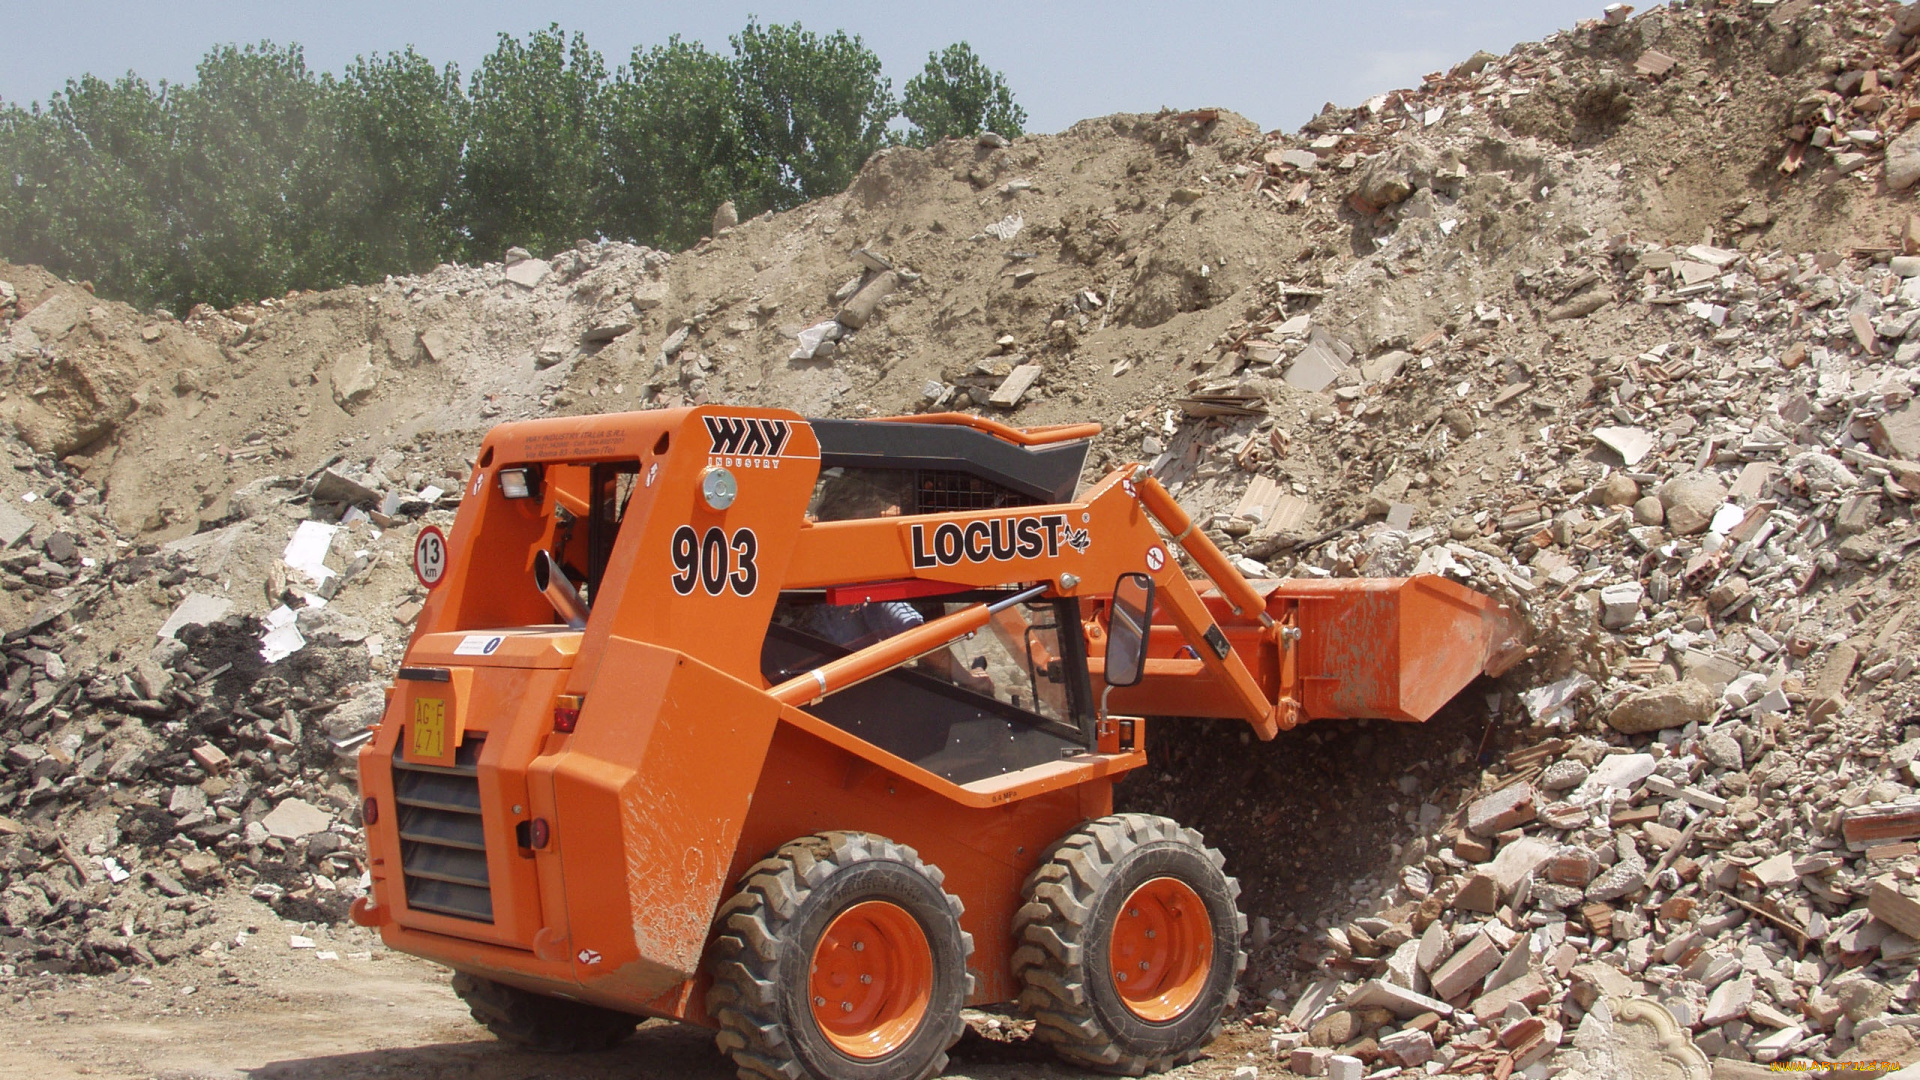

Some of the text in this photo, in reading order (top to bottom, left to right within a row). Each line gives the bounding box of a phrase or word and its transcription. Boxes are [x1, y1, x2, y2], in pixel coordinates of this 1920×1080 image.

[702, 416, 788, 457] WAY
[708, 457, 779, 469] INDUSTRY
[421, 539, 440, 564] 13
[911, 514, 1064, 569] LOCUST
[425, 565, 437, 577] km
[671, 525, 758, 597] 903
